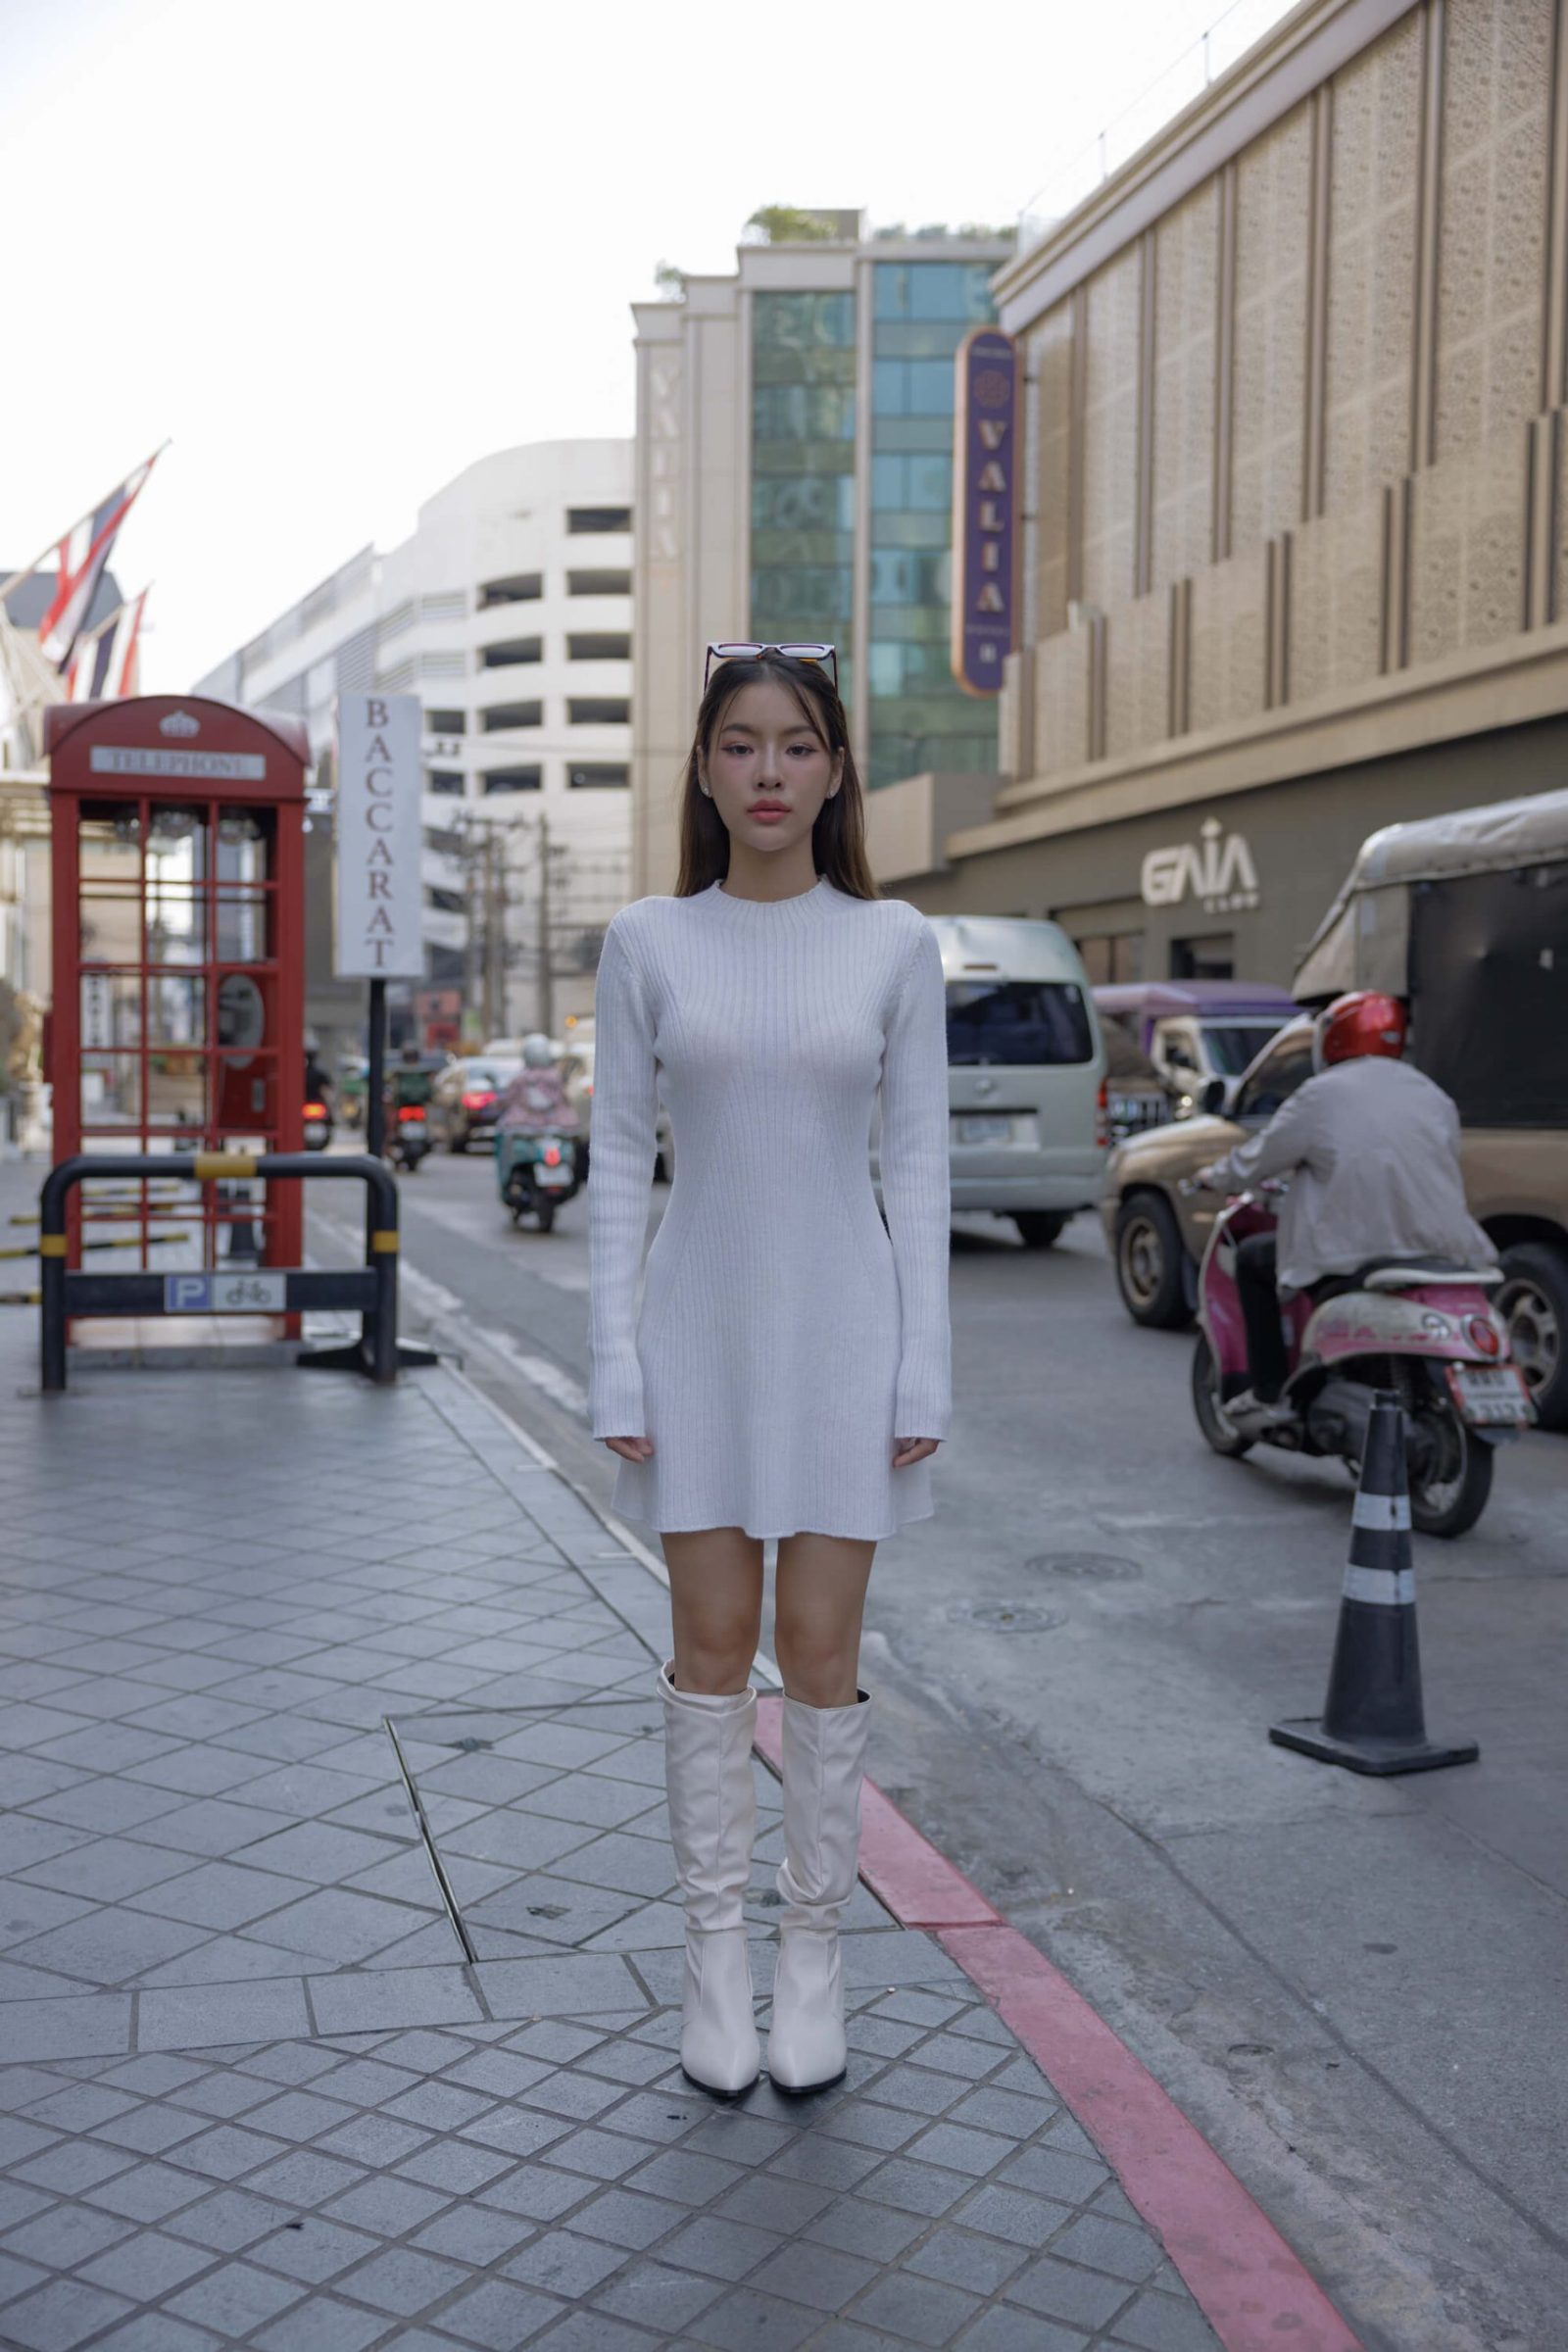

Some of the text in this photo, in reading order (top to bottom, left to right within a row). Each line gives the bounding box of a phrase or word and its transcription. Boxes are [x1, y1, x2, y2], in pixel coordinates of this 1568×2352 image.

[977, 419, 1006, 612] VALIA
[110, 750, 247, 775] TELEPHONE
[365, 699, 395, 968] BACCARAT
[177, 1278, 205, 1307] P
